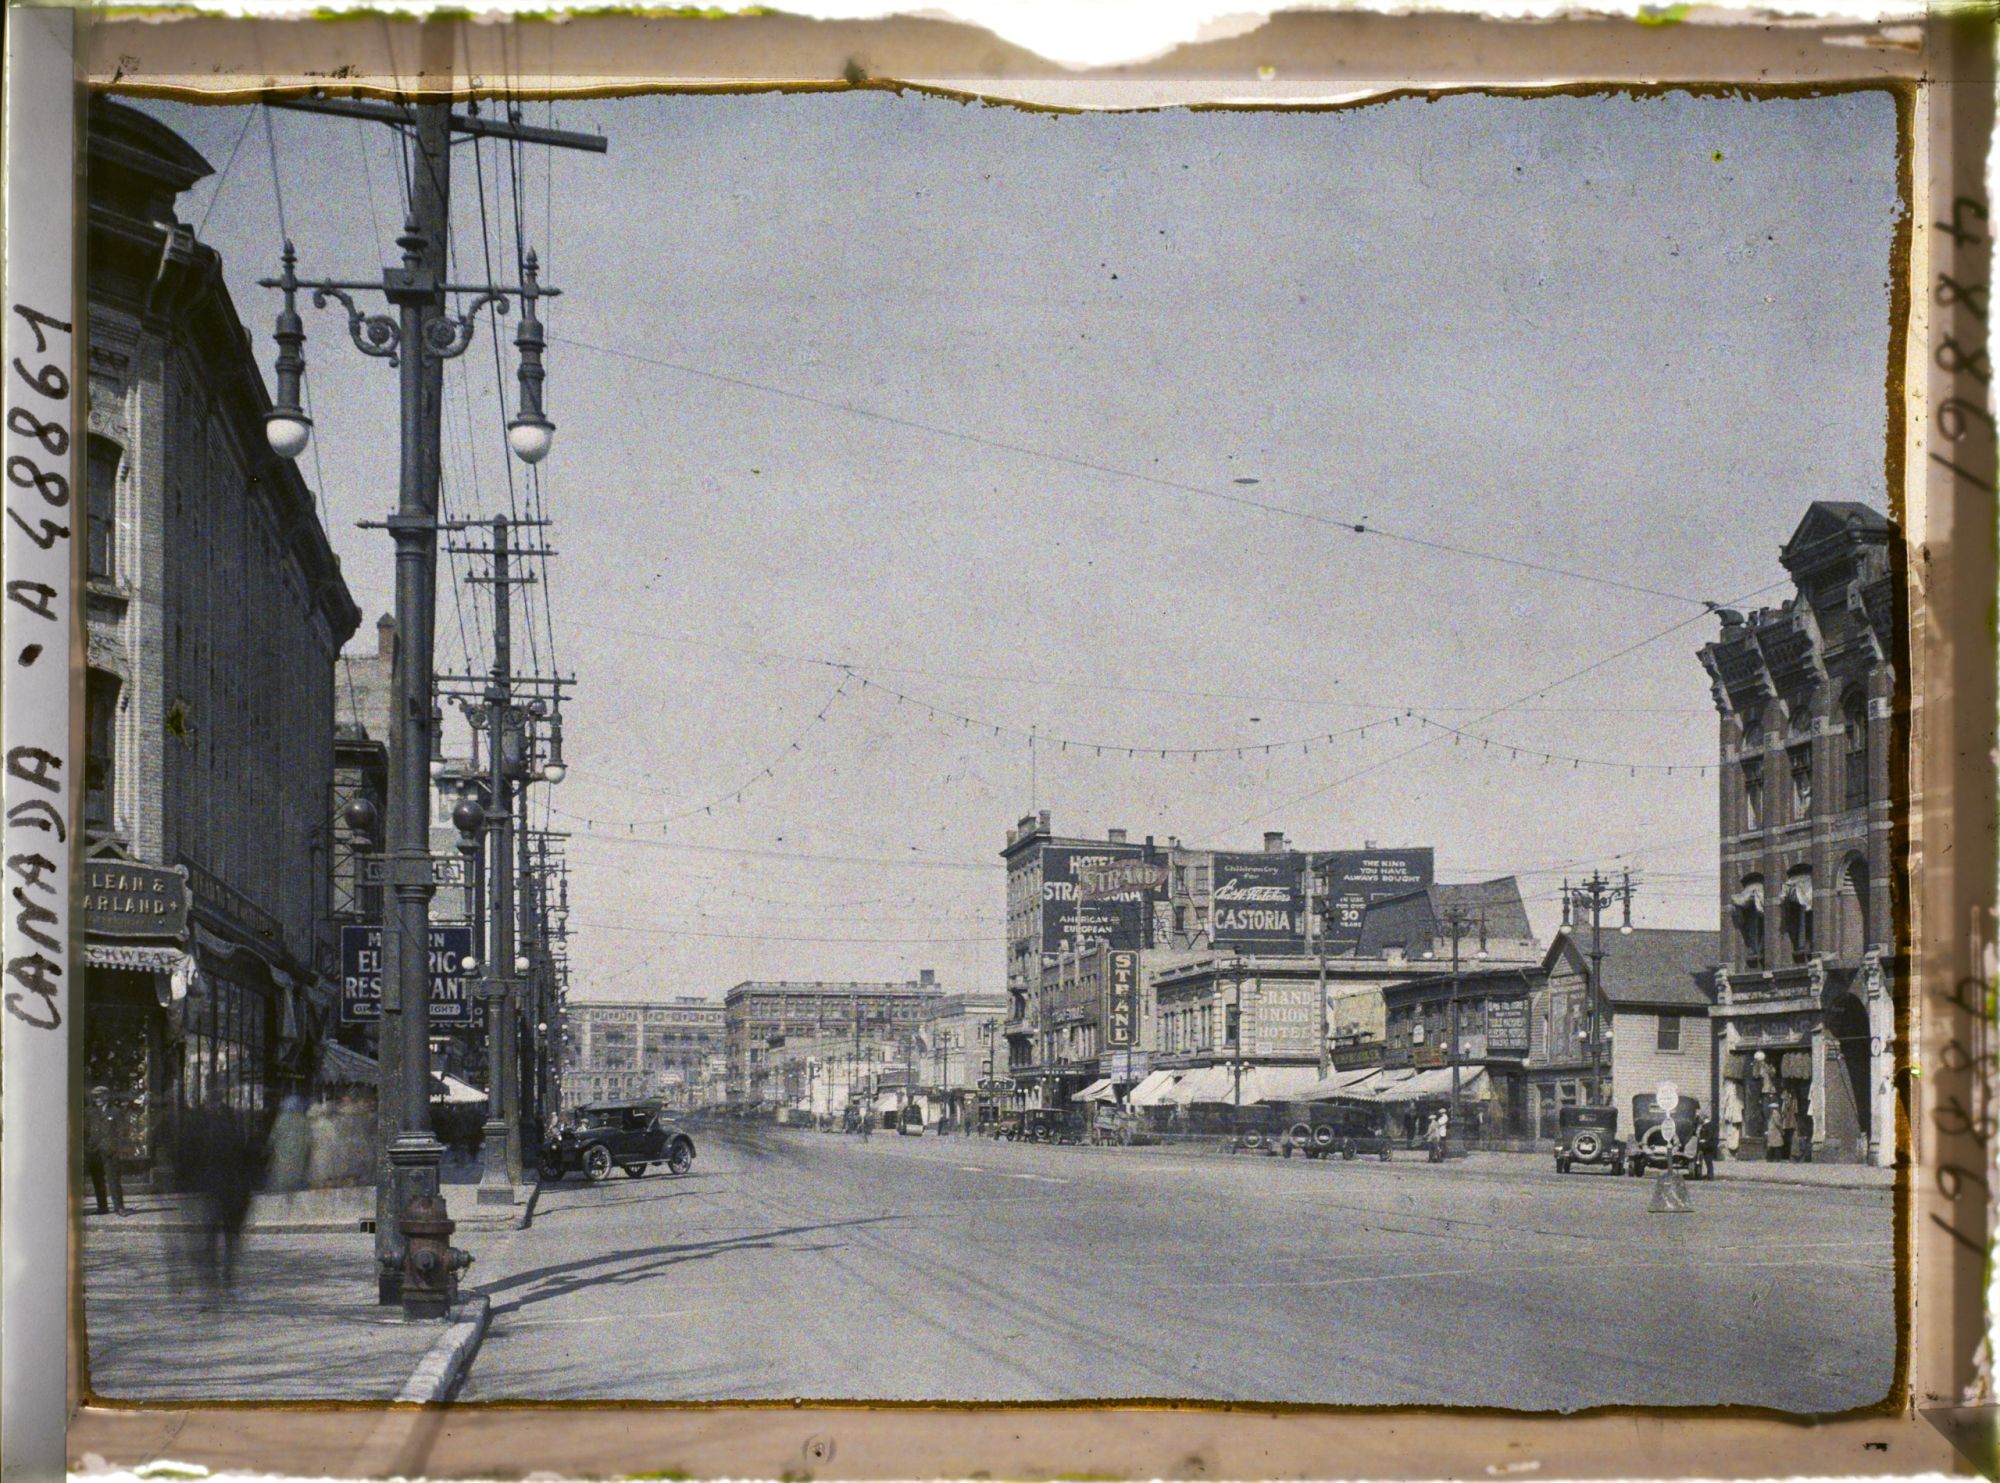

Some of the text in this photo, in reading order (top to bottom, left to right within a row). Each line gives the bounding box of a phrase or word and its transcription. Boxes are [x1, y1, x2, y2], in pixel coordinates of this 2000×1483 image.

[6, 745, 66, 1031] CANADA
[153, 880, 165, 892] &
[83, 895, 164, 913] ARLAND
[1215, 908, 1291, 930] CASTORIA
[1341, 910, 1359, 921] 30
[1063, 925, 1113, 933] EUOPEAN
[359, 950, 456, 973] ELRIC
[345, 976, 468, 1000] RESANT
[1258, 1007, 1310, 1022] UNION
[1259, 1026, 1312, 1040] HOTEL
